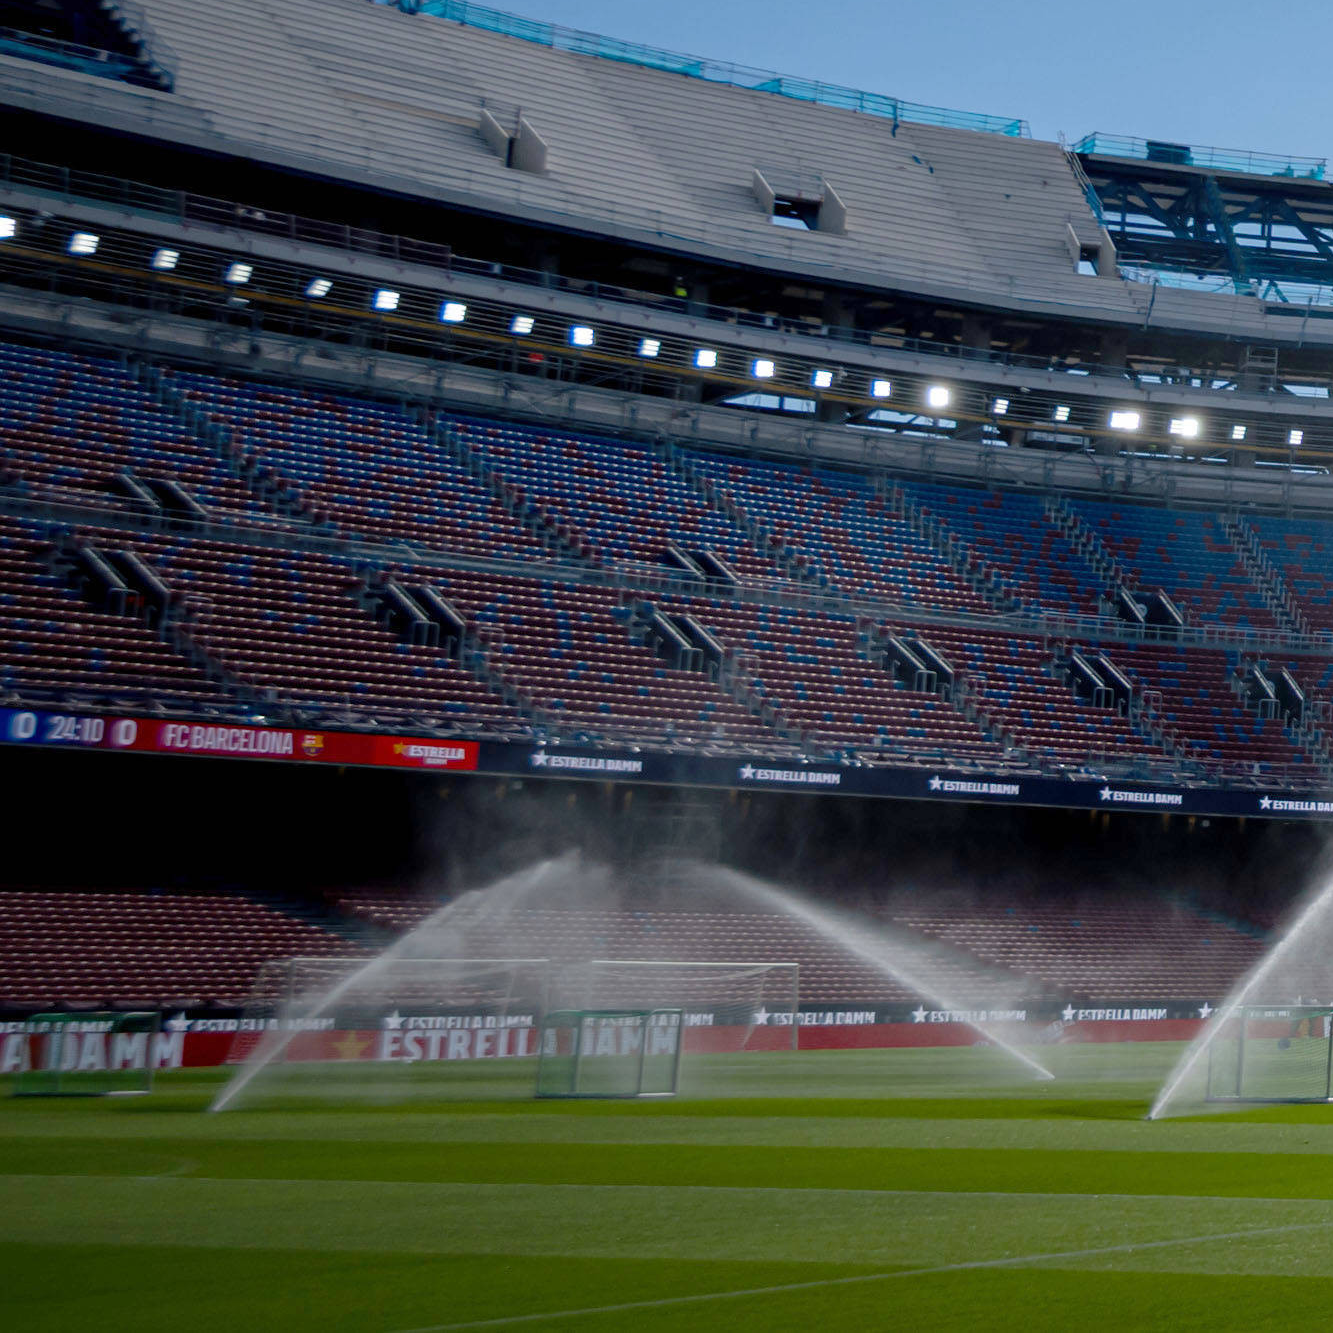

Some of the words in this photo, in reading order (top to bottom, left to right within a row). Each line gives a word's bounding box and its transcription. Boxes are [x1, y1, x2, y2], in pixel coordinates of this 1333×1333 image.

[12, 712, 36, 739] 0
[48, 716, 104, 743] 24:10
[111, 719, 137, 746] 0
[162, 724, 190, 748] FC
[191, 726, 293, 756] BARCELONA
[407, 745, 465, 760] ESTRELLA
[550, 756, 605, 771] ESTRELLA
[606, 758, 642, 773] DAMM
[757, 768, 807, 783] ESTRELLA
[808, 770, 840, 785] DAMM
[943, 780, 989, 794] ESTRELLA
[990, 783, 1019, 795] DAMM
[1112, 791, 1155, 804] ESTRELLA
[1156, 793, 1182, 805] DAMM
[1272, 801, 1316, 812] ESTRELLA
[1078, 1008, 1131, 1021] ESTRELLA
[1132, 1008, 1167, 1020] DAMM
